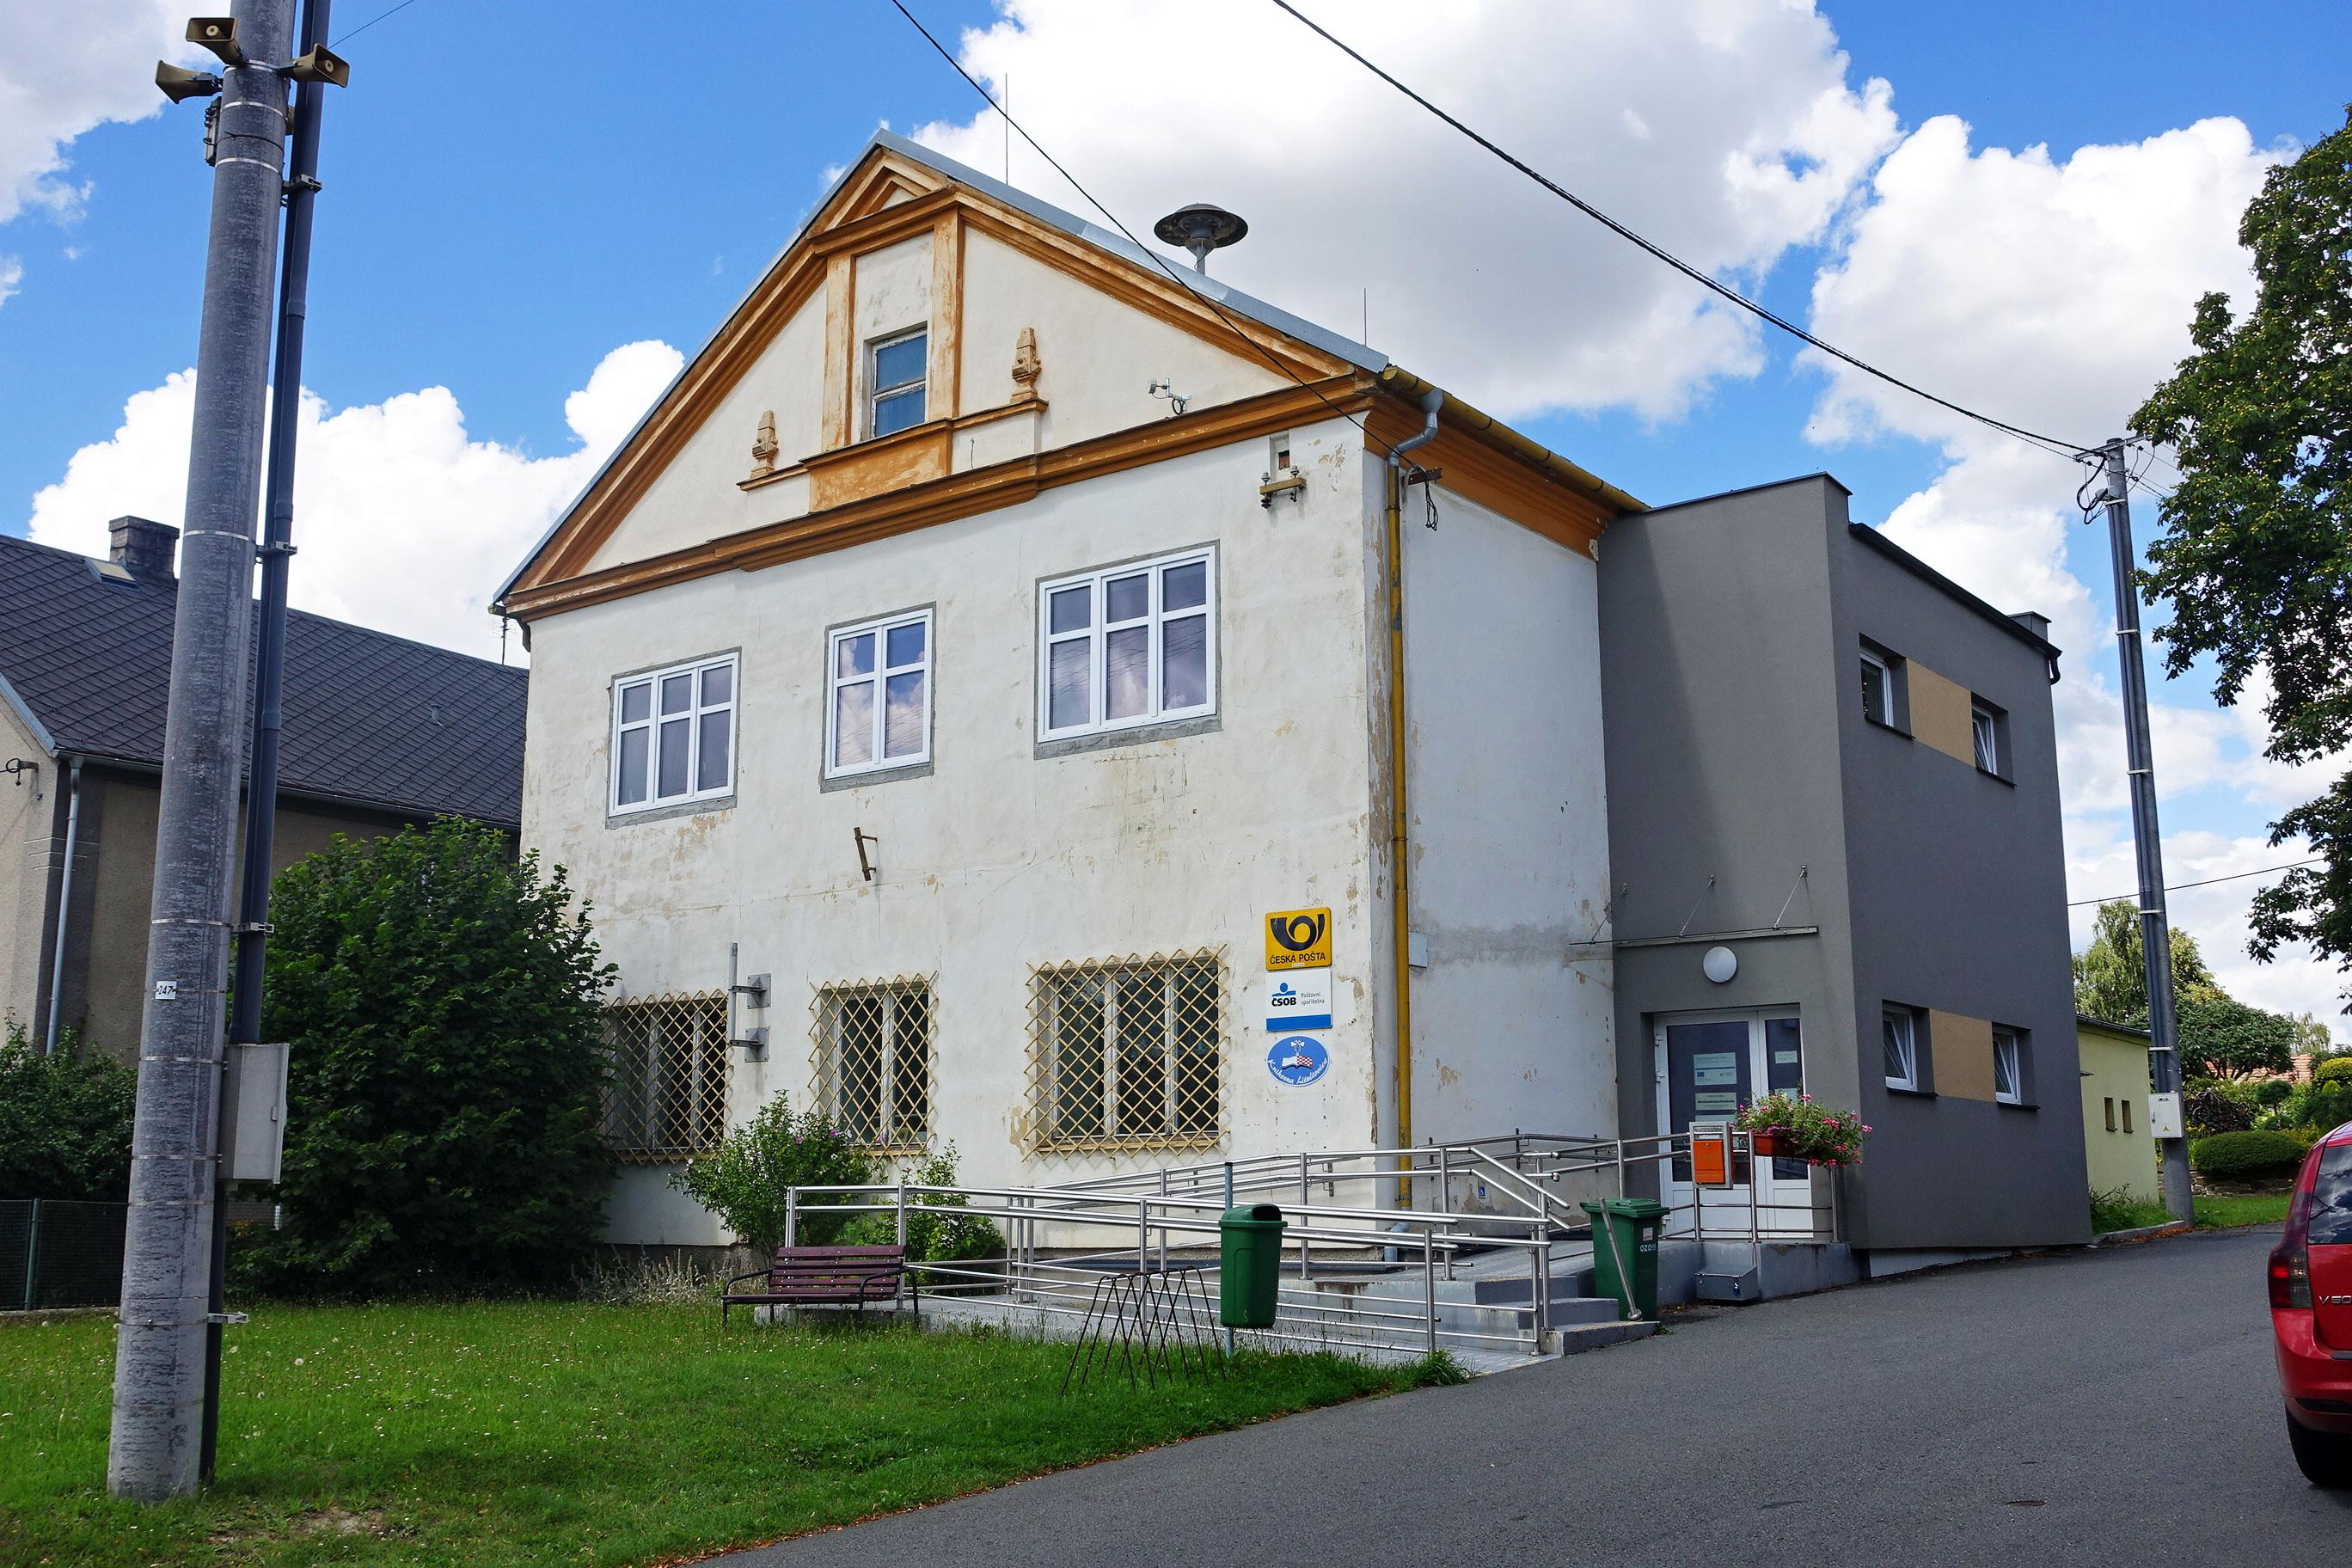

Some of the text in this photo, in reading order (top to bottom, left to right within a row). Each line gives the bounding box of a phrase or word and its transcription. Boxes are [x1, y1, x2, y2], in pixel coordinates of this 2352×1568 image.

[1270, 951, 1326, 965] ČESKÁ POŠTA
[158, 985, 173, 995] 247
[1271, 997, 1297, 1007] ČSOB
[1268, 1059, 1295, 1084] Knihovna
